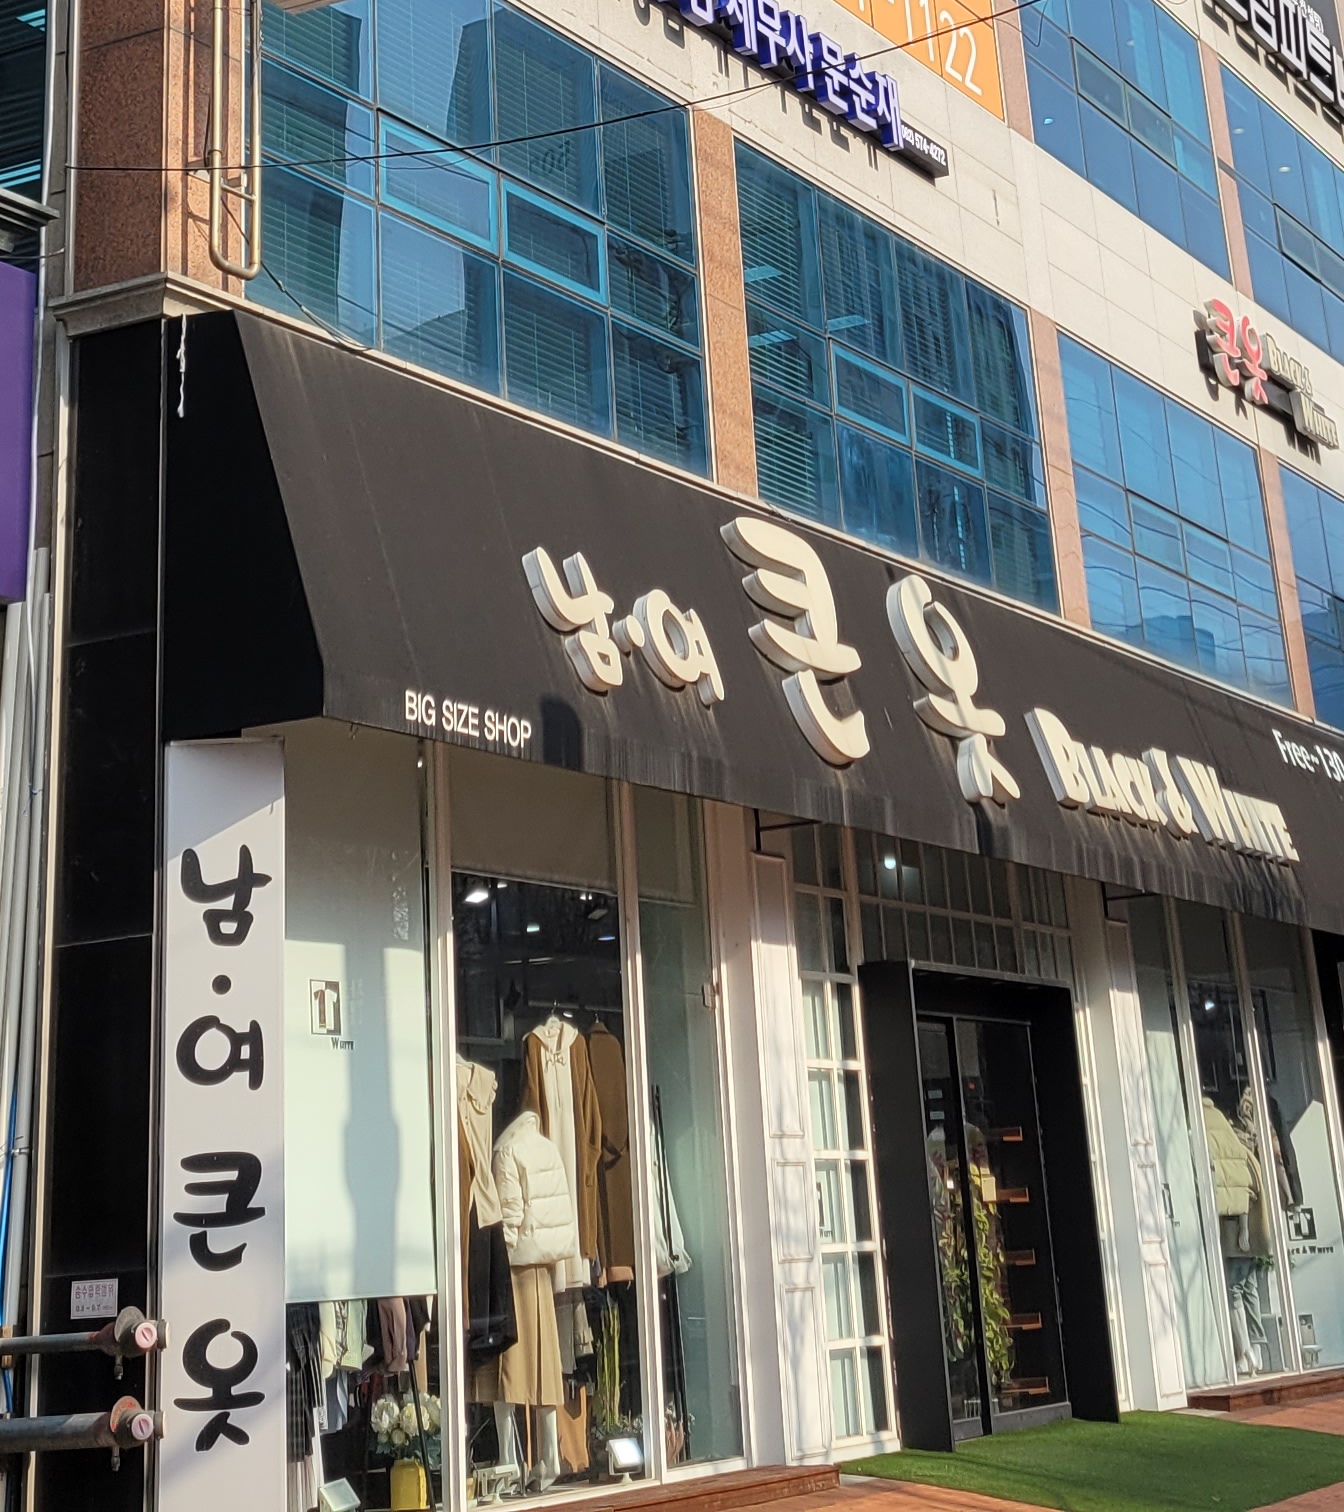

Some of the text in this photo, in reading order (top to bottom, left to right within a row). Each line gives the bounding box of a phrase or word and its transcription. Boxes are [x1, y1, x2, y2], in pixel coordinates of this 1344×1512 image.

[404, 689, 533, 749] BIG SIZE SHOP
